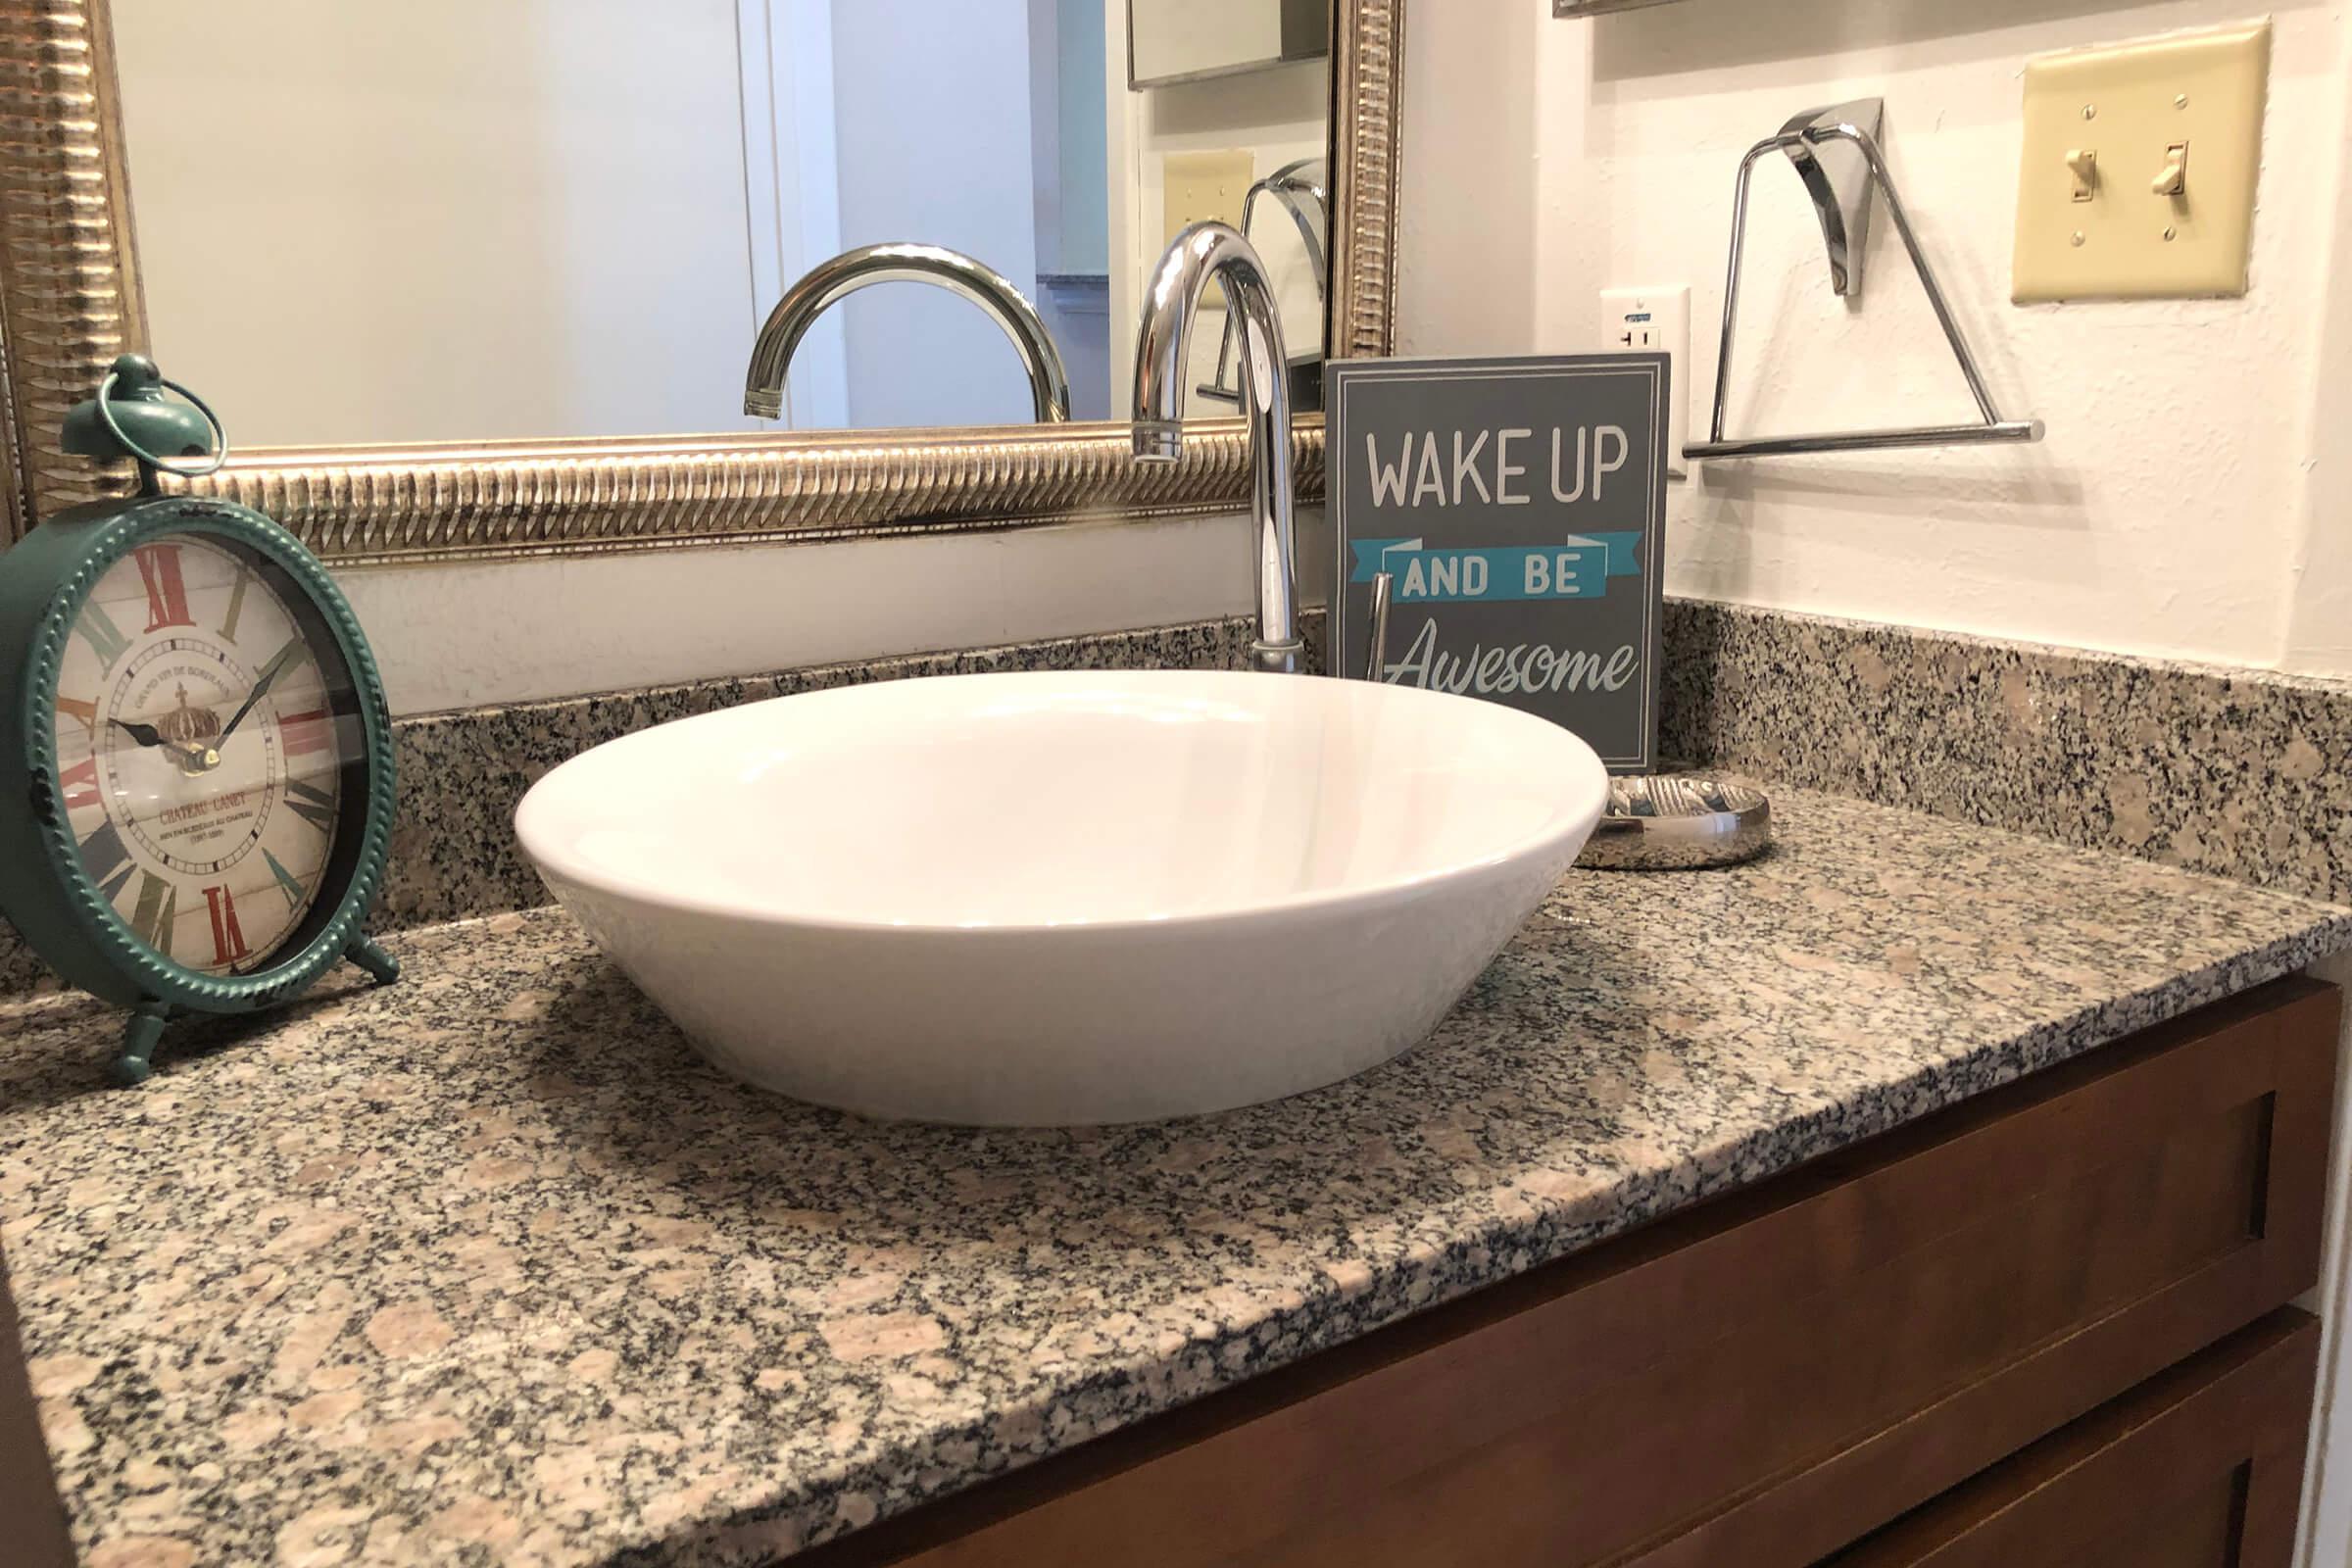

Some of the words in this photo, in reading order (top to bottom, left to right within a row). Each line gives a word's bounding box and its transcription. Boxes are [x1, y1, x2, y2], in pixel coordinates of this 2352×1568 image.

[1366, 428, 1533, 508] WAKE
[1550, 424, 1629, 503] UP
[1401, 556, 1489, 598] AND
[1524, 553, 1582, 595] BE
[1384, 617, 1640, 694] Awesome
[160, 800, 208, 825] CHATEAU
